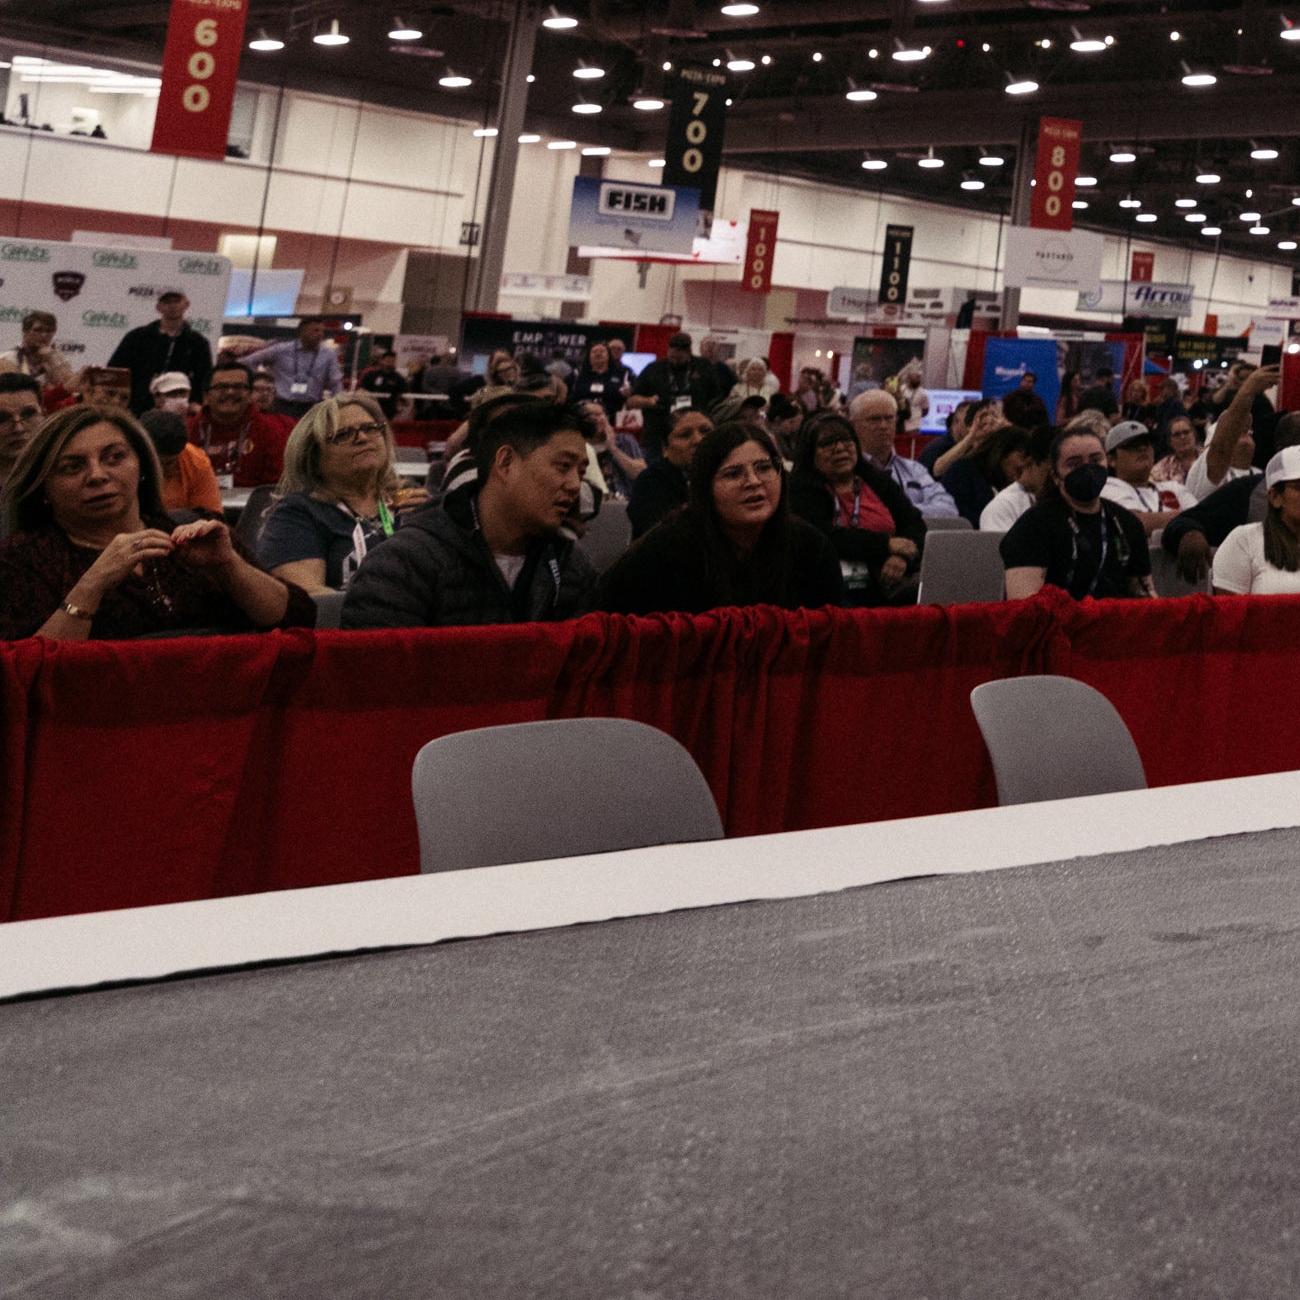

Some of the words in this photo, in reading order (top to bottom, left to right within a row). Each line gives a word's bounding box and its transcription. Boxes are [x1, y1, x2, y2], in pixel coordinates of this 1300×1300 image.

[182, 18, 218, 112] 600
[682, 91, 709, 173] 700
[608, 190, 666, 213] FISH
[1045, 146, 1065, 216] 800
[750, 227, 767, 289] 1000
[887, 241, 901, 300] 1100
